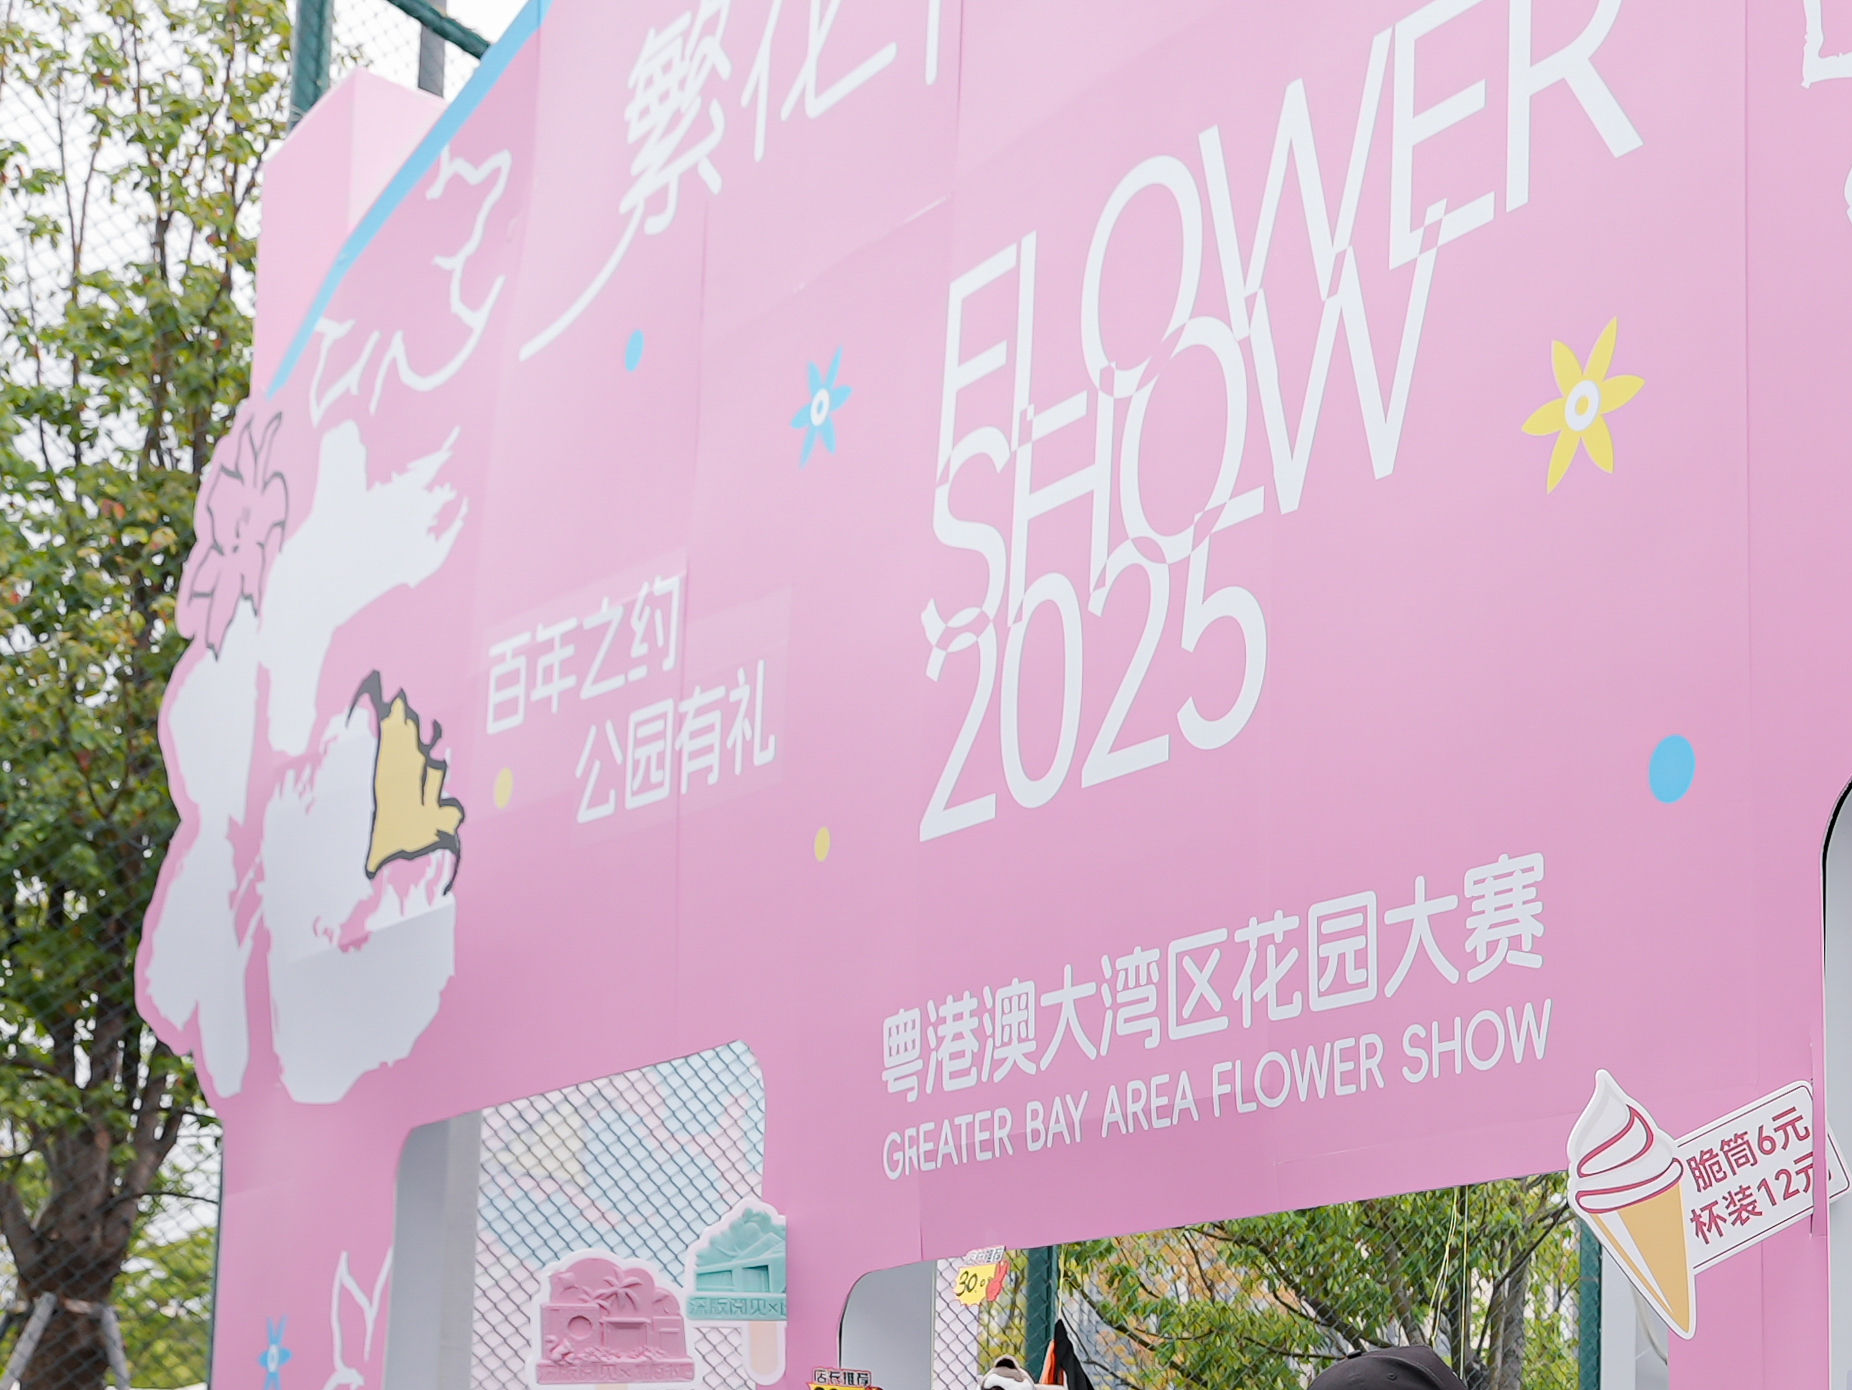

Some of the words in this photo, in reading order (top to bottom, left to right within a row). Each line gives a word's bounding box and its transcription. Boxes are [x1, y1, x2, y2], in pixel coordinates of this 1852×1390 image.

[934, 0, 1645, 486] FLOWER
[920, 197, 1447, 653] SHOW
[487, 575, 681, 736] 百年之约
[574, 659, 777, 824] 公园有礼
[919, 485, 1268, 842] 2025
[882, 852, 1544, 1102] 粤港澳大湾区花园大赛
[882, 1107, 1013, 1180] GREATER
[1026, 1090, 1089, 1151] BAY
[1102, 1070, 1199, 1138] AREA
[1213, 1033, 1385, 1118] FLOWER
[1401, 998, 1552, 1083] SHOW
[1686, 1107, 1812, 1193] 脆筒6元
